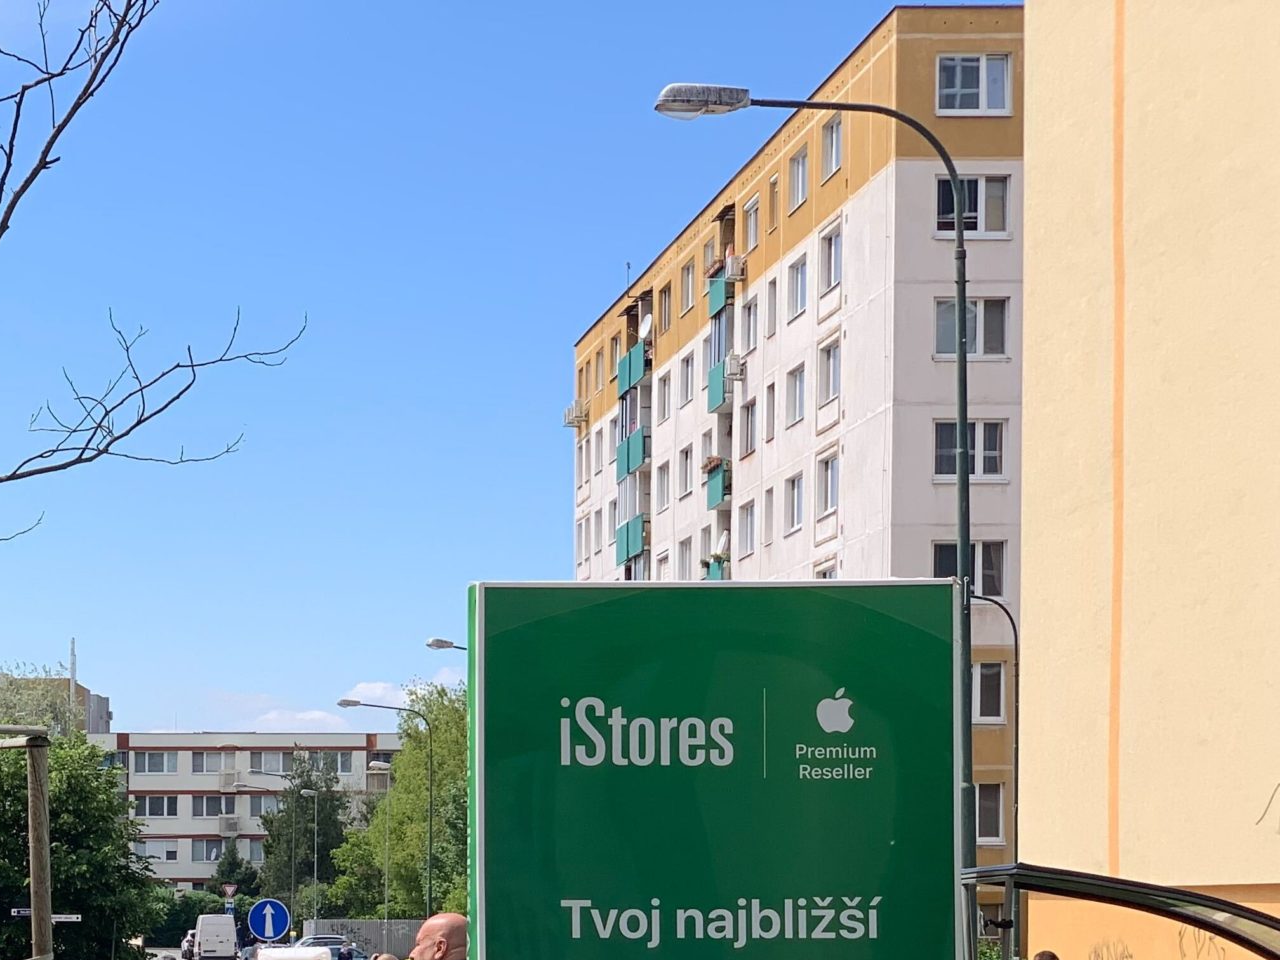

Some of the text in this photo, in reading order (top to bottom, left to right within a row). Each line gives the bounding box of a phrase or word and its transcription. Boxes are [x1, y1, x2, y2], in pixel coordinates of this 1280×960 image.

[560, 696, 734, 767] iStores
[795, 743, 877, 759] Premium
[799, 763, 873, 780] Reseller
[560, 896, 883, 949] Tvoj najbližší
